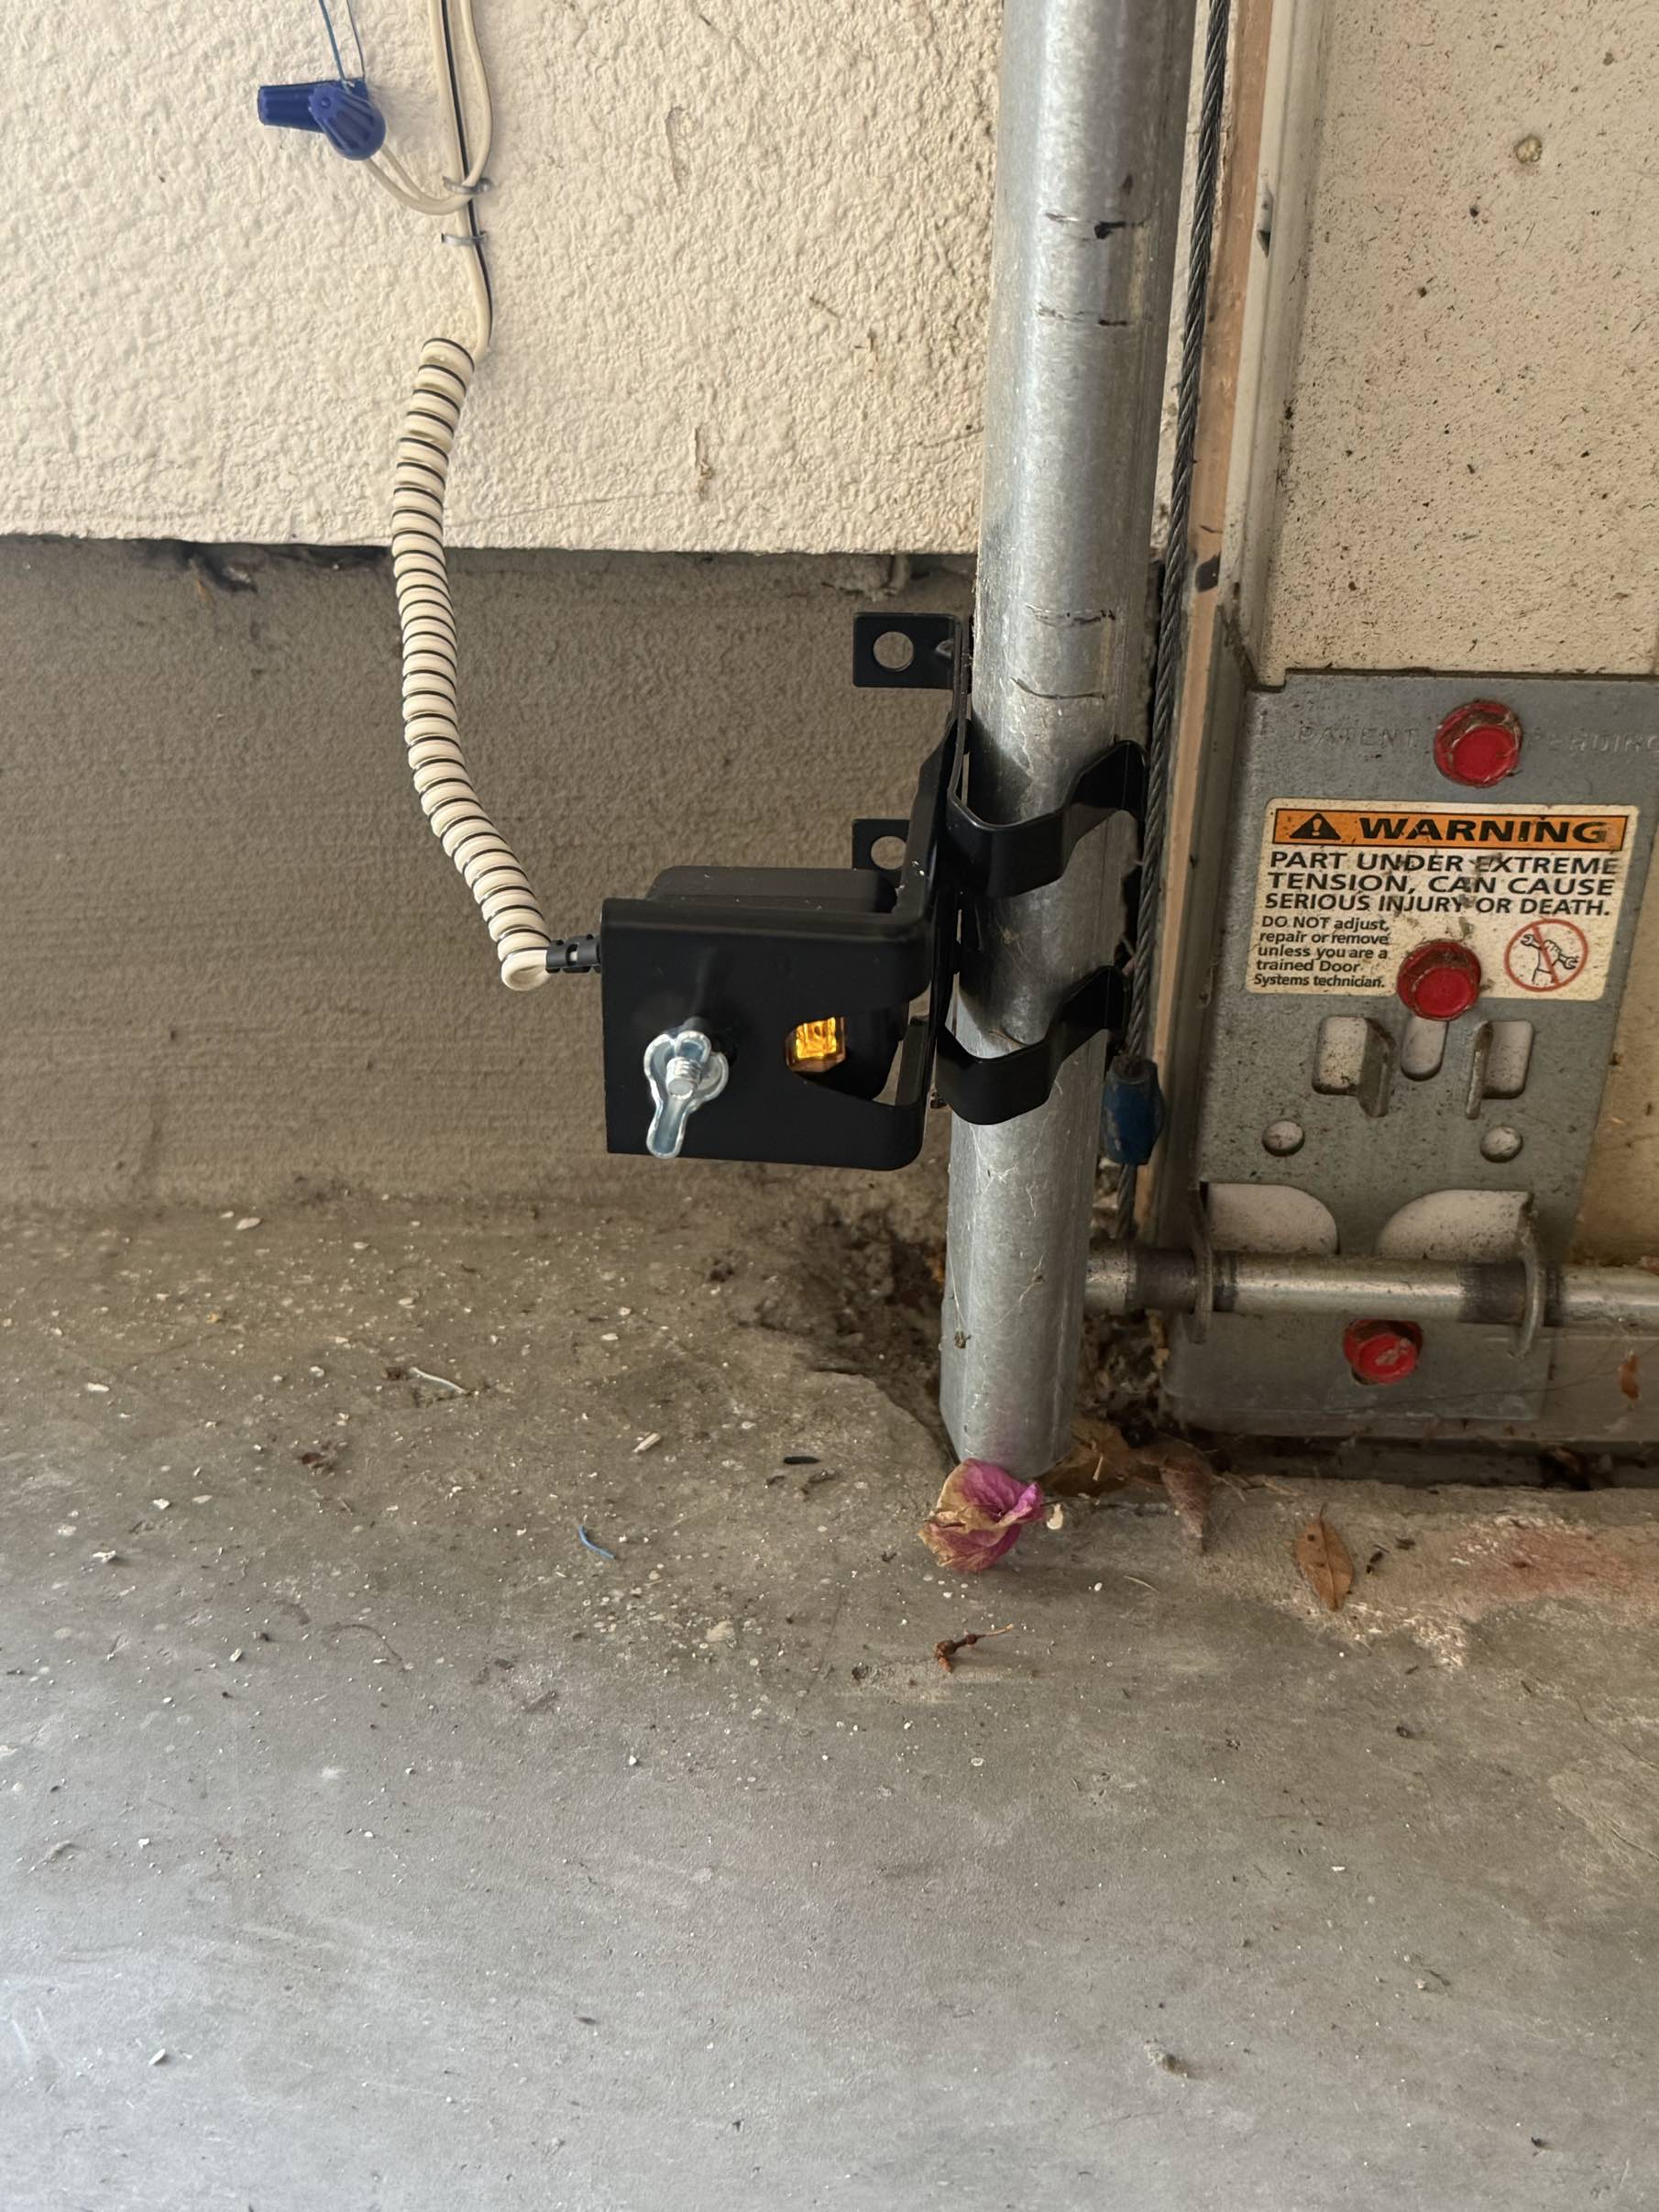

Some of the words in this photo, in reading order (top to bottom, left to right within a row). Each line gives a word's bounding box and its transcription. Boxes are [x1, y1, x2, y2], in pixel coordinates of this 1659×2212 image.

[1359, 818, 1608, 843] WARNING
[1270, 851, 1347, 869] PART
[1357, 853, 1464, 871] UNDER
[1476, 854, 1620, 875] EXTREME
[1268, 872, 1416, 894] TENSION,
[1428, 875, 1496, 893] CAN
[1508, 877, 1616, 896] CAUSE
[1265, 893, 1370, 910] SERIOUS
[1379, 895, 1467, 912] INJURY
[1476, 897, 1512, 913] OR
[1520, 898, 1610, 916] DEATH.
[1262, 916, 1288, 928] DO
[1293, 917, 1330, 929] NOT
[1335, 918, 1390, 932] adjust,
[1259, 930, 1307, 944] repair
[1312, 932, 1327, 942] or
[1332, 933, 1389, 944] remove
[1258, 945, 1311, 956] unless
[1316, 948, 1345, 960] you
[1349, 949, 1374, 959] are
[1379, 950, 1388, 959] a
[1257, 959, 1313, 971] trained
[1320, 961, 1360, 972] Door
[1254, 974, 1309, 987] Systems
[1313, 974, 1385, 987] technician.
